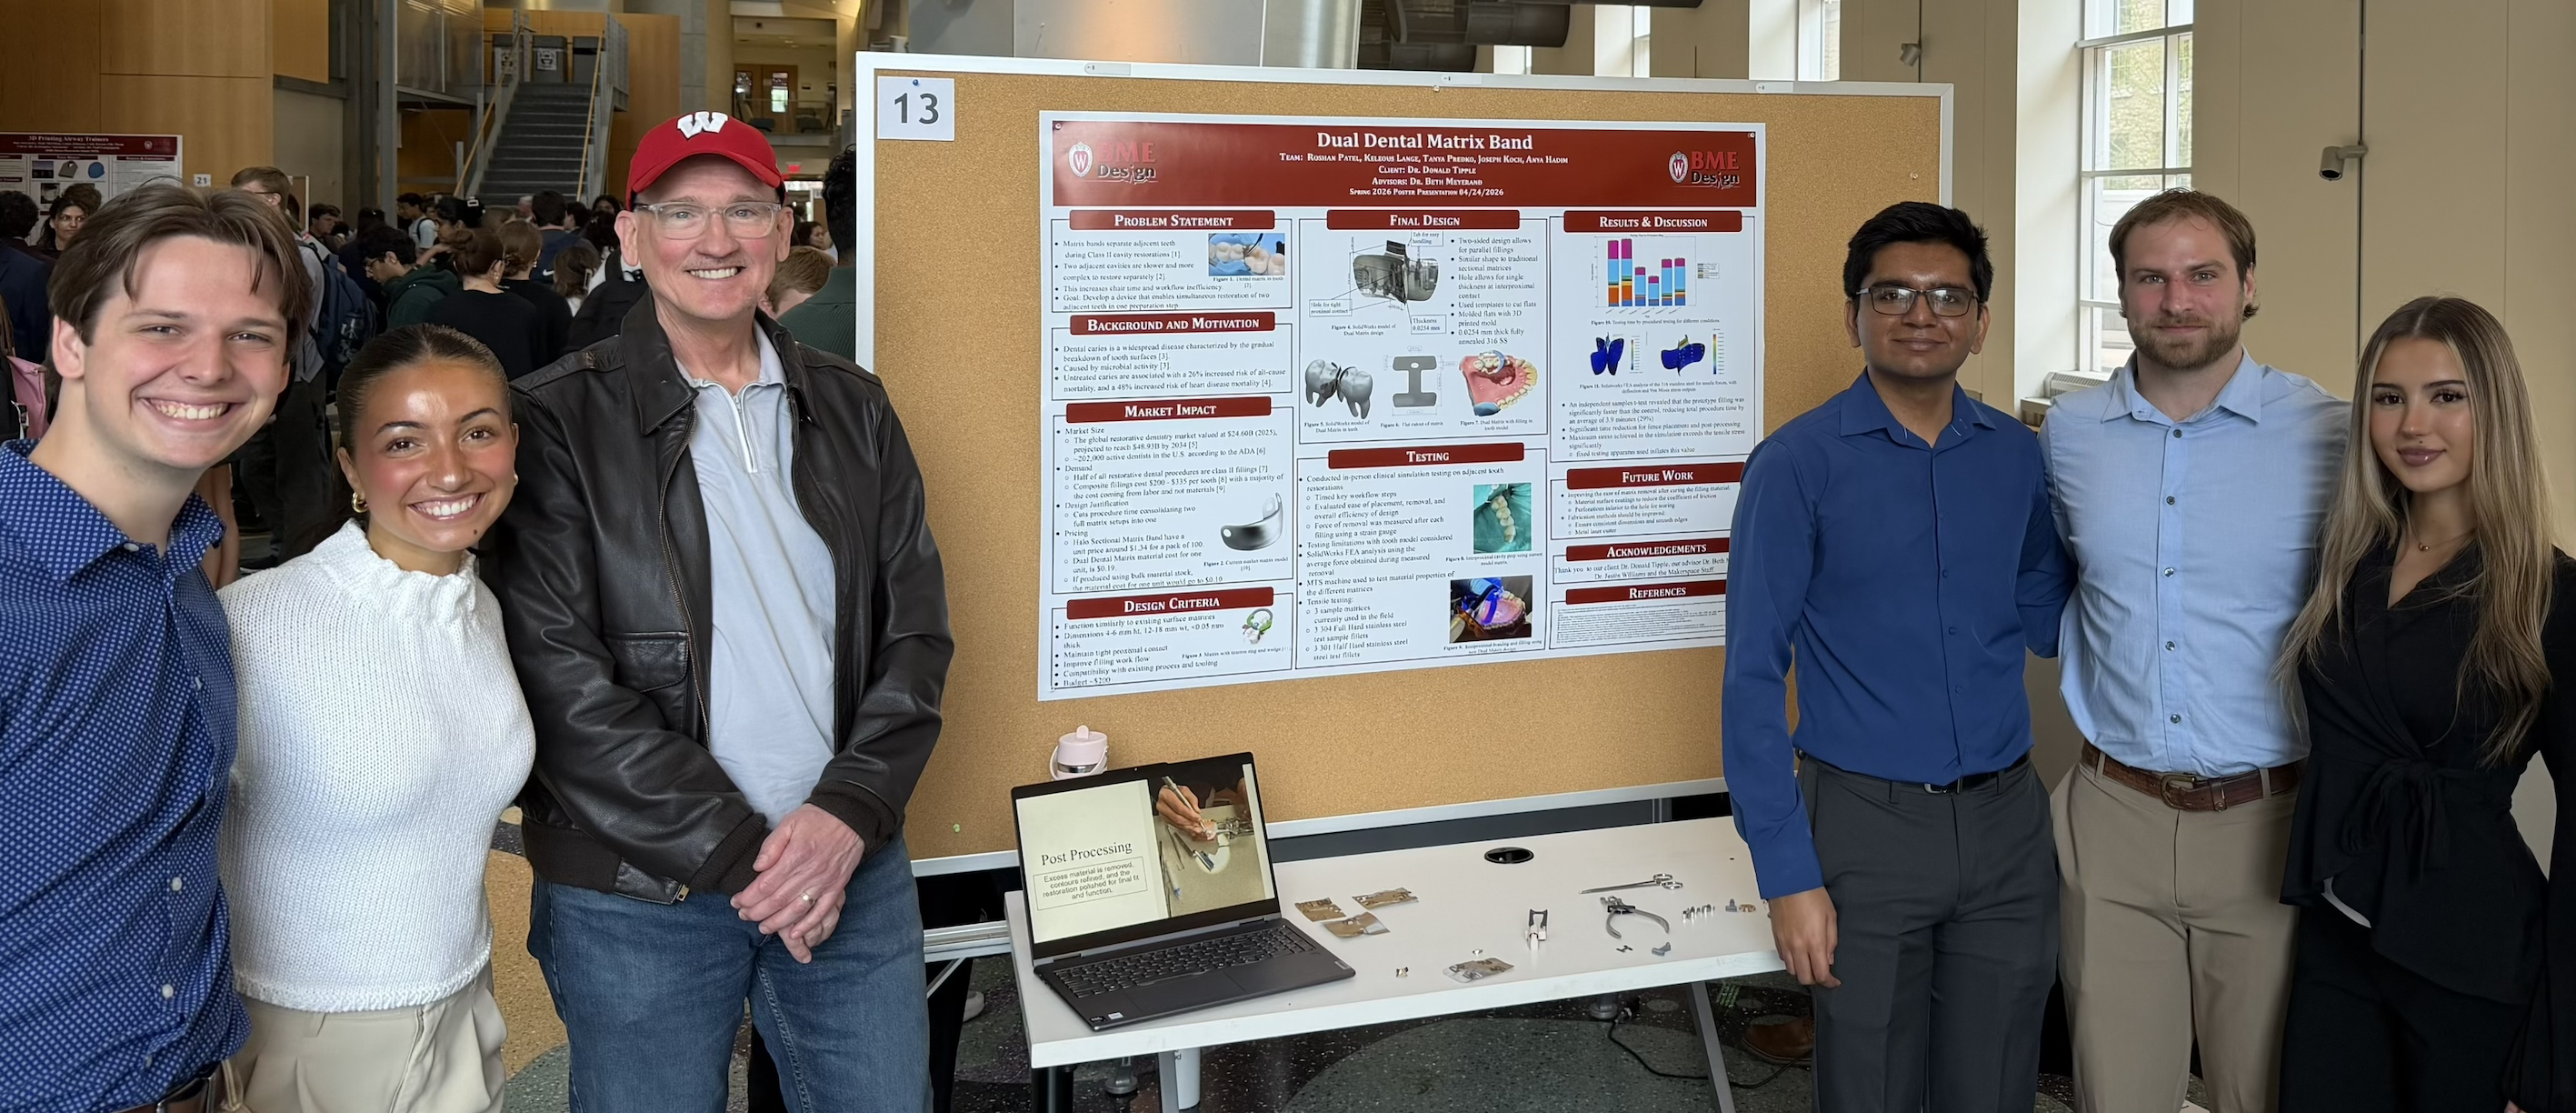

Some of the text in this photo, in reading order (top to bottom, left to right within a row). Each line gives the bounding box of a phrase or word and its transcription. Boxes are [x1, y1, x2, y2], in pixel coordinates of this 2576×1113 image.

[894, 93, 939, 124] 13
[677, 111, 728, 138] W
[1318, 132, 1532, 149] Dual Dental Matrix Band
[1097, 142, 1156, 162] BME
[1279, 152, 1302, 160] TEAM:
[1307, 153, 1335, 161] ROSHAN
[1338, 153, 1361, 162] PATEL,
[1396, 154, 1420, 162] LANGE,
[1478, 154, 1501, 164] JOSEPH
[1503, 155, 1524, 164] KOCH,
[1691, 151, 1739, 170] BME
[1098, 164, 1156, 184] Design
[1691, 171, 1740, 190] Design
[1459, 188, 1503, 197] 04/24/2026
[1114, 214, 1233, 226] PROBLEM STATEMENT
[1390, 214, 1459, 225] FINAL DESIGN
[1600, 216, 1707, 227] RESULTS & DISCUSSION
[1088, 317, 1258, 331] BACKGROUND AND MOTIVATION
[1125, 404, 1216, 417] MARKET IMPACT
[1406, 451, 1448, 462] TESTING
[1622, 470, 1693, 482] FUTURE WORK
[1607, 544, 1706, 558] ACKNOWLEDGEMENTS
[1629, 587, 1685, 599] REFERENCES
[1124, 597, 1219, 612] DESIGN CRITERIA
[1042, 842, 1132, 866] Post Processing
